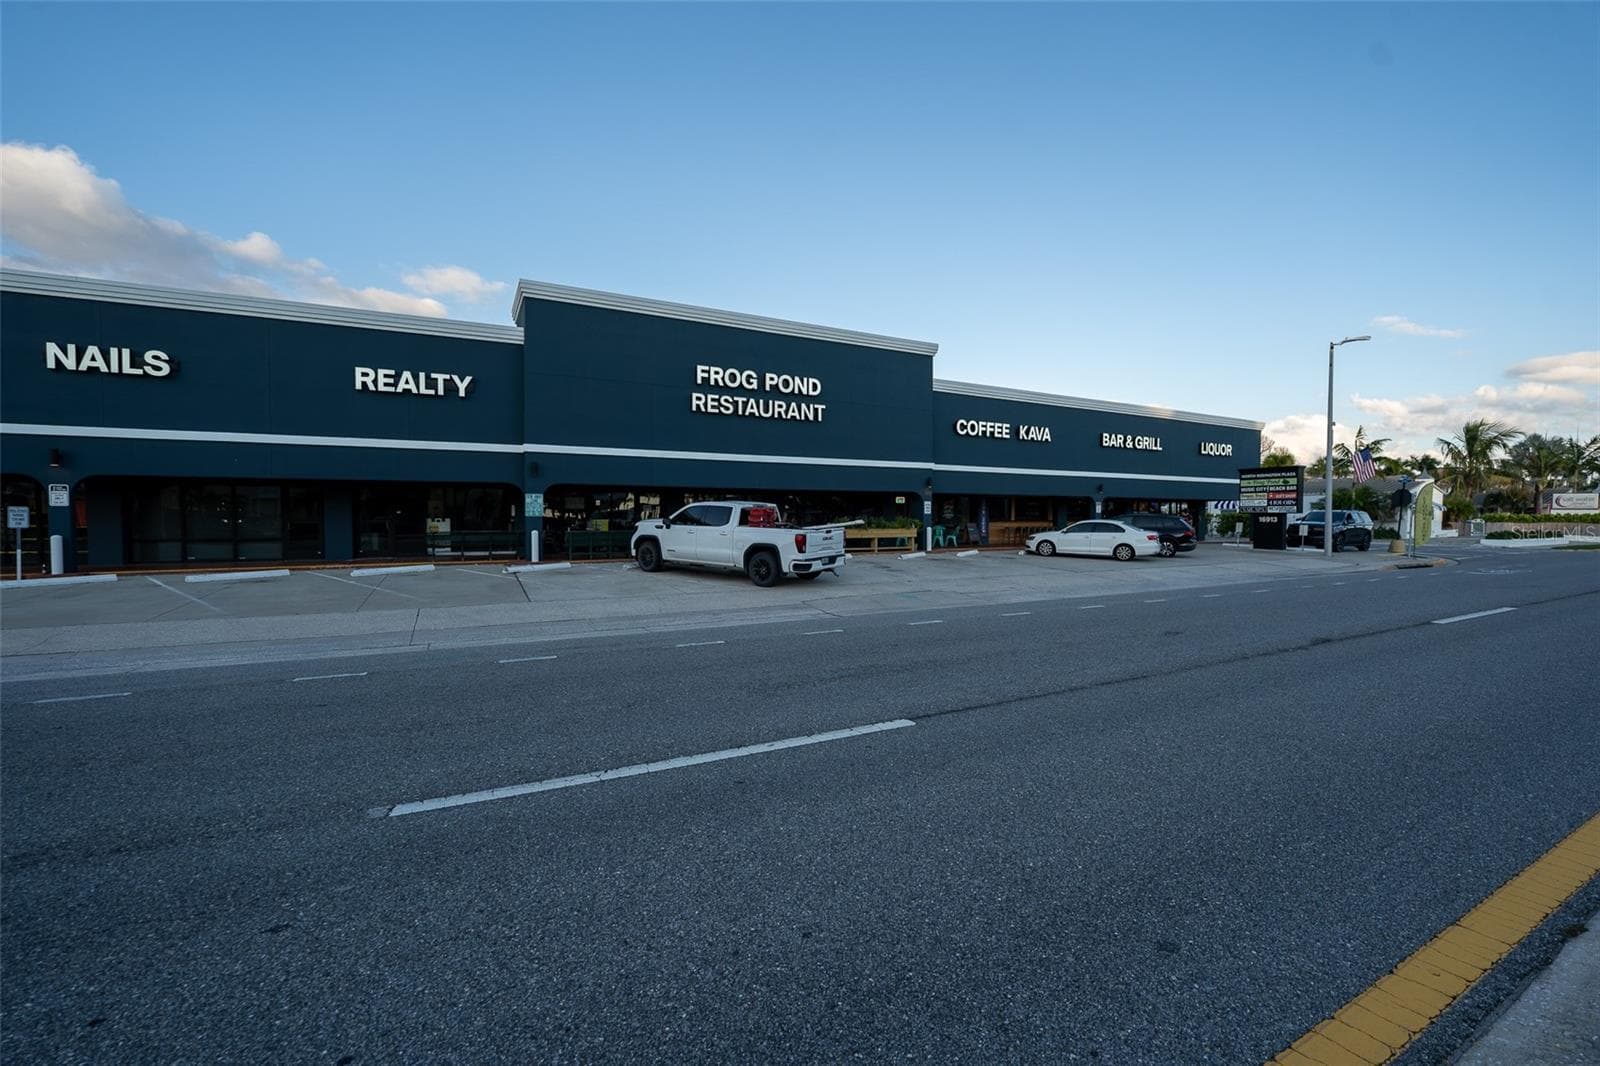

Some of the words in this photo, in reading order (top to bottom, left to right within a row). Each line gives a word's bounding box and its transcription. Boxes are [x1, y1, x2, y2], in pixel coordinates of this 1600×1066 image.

[45, 341, 171, 378] NAILS
[354, 366, 473, 398] REALTY
[696, 364, 758, 390] FROG
[765, 373, 821, 396] POND
[691, 393, 825, 422] RESTAURANT
[956, 419, 1011, 439] COFFEE
[1019, 425, 1052, 442] KAVA
[1102, 432, 1125, 448] BAR
[1134, 435, 1163, 451] GRILL
[1201, 442, 1233, 457] LIQUOR
